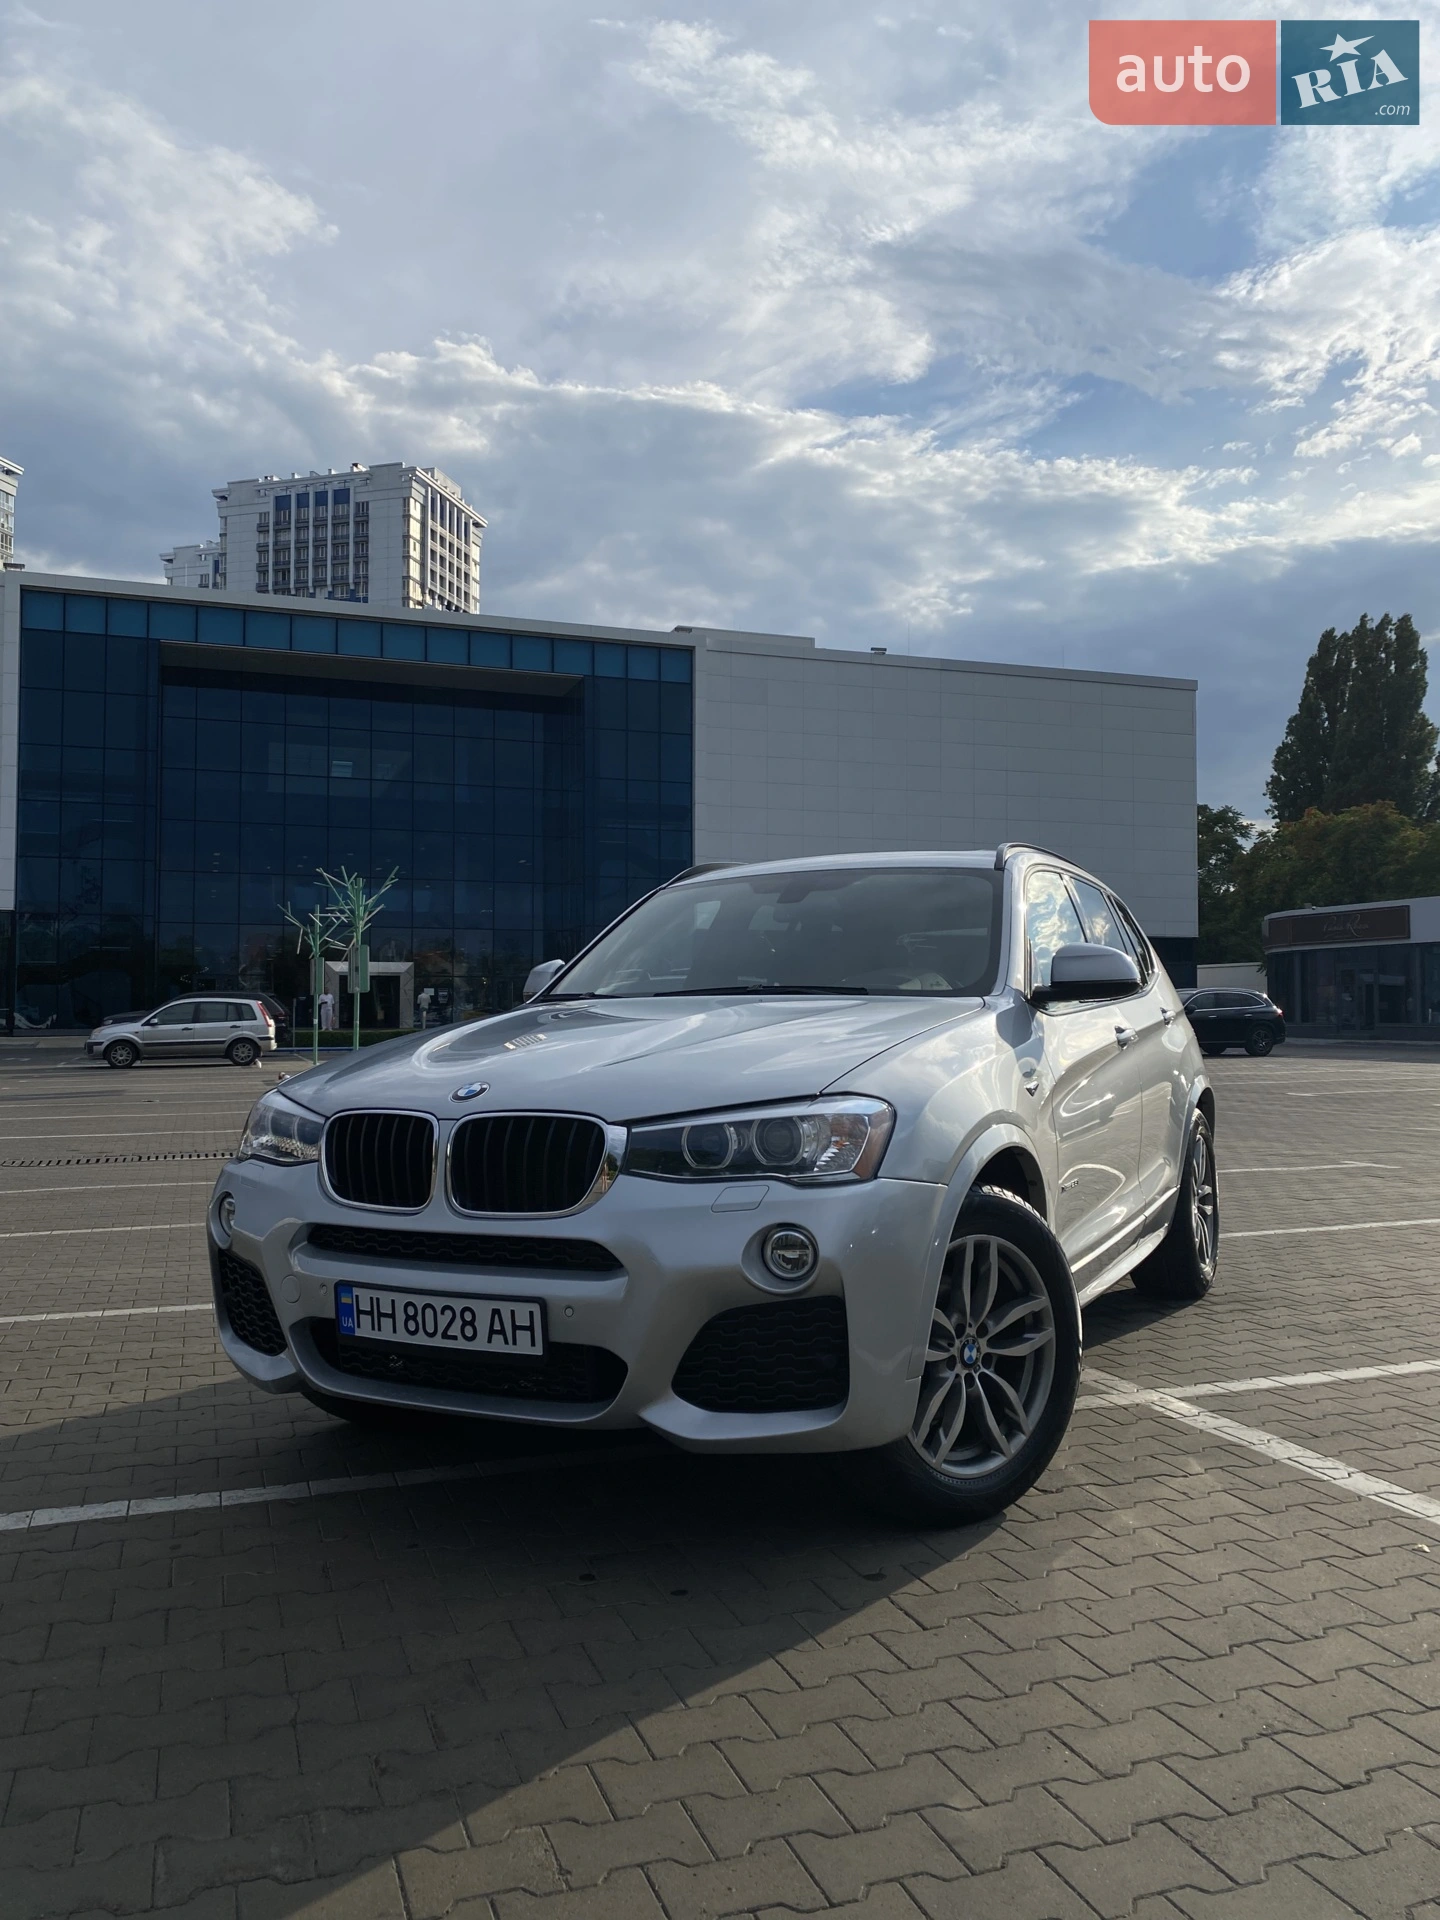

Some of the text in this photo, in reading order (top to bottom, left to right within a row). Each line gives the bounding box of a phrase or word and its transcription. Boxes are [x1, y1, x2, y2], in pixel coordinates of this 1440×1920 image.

[341, 1316, 354, 1329] UA
[355, 1294, 536, 1347] HH 8028 AH
